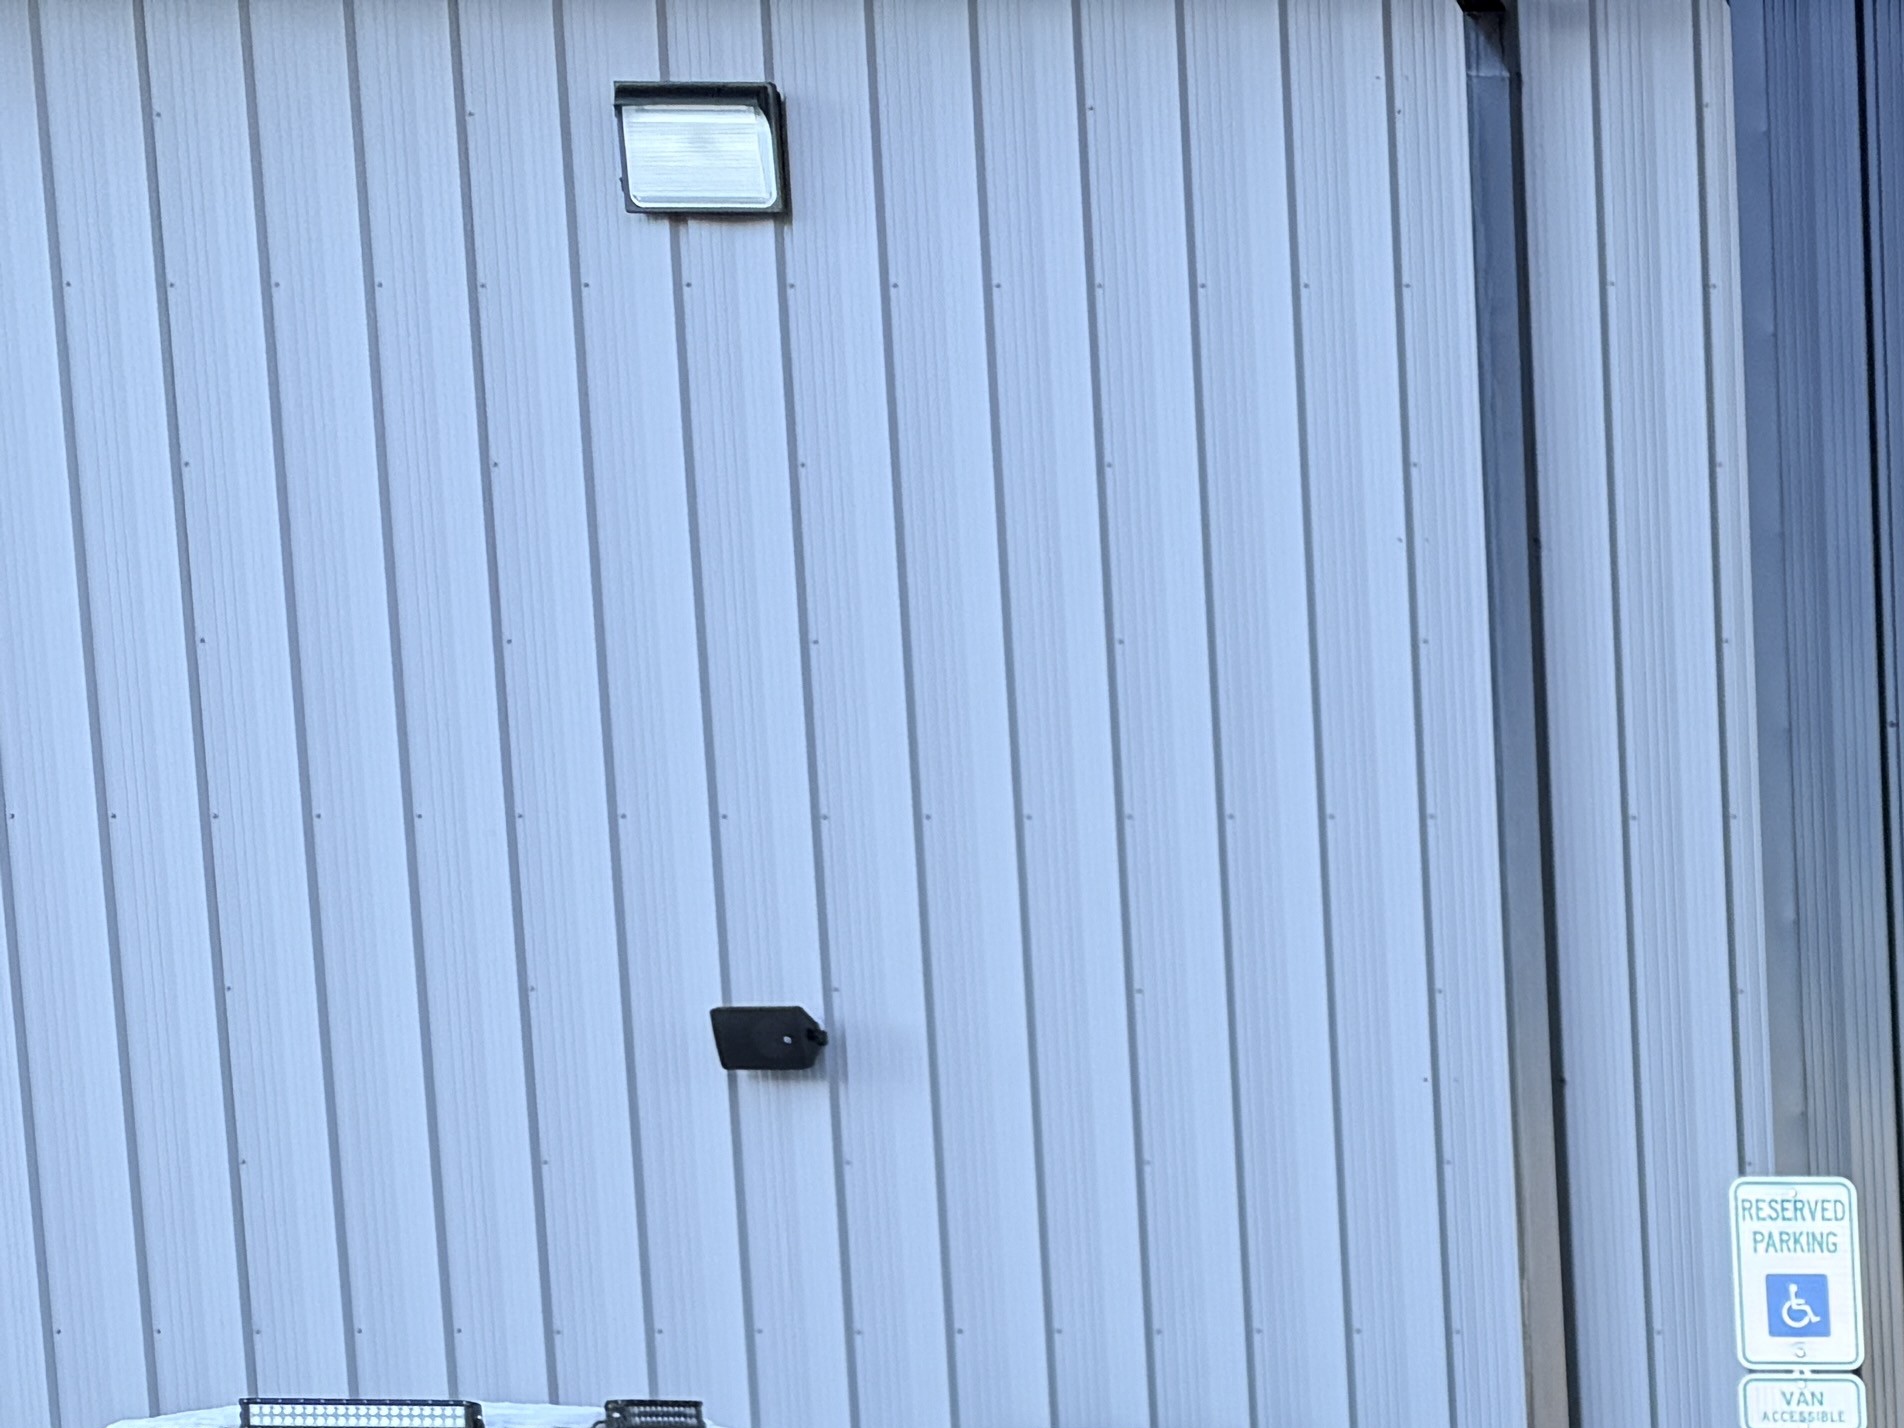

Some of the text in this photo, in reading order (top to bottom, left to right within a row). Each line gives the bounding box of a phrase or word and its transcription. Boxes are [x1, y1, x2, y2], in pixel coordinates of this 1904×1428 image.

[1741, 1198, 1846, 1223] RESERVED
[1752, 1231, 1838, 1254] PARKING
[1780, 1390, 1825, 1407] VAN
[1761, 1411, 1846, 1424] ACCESSIBLE
